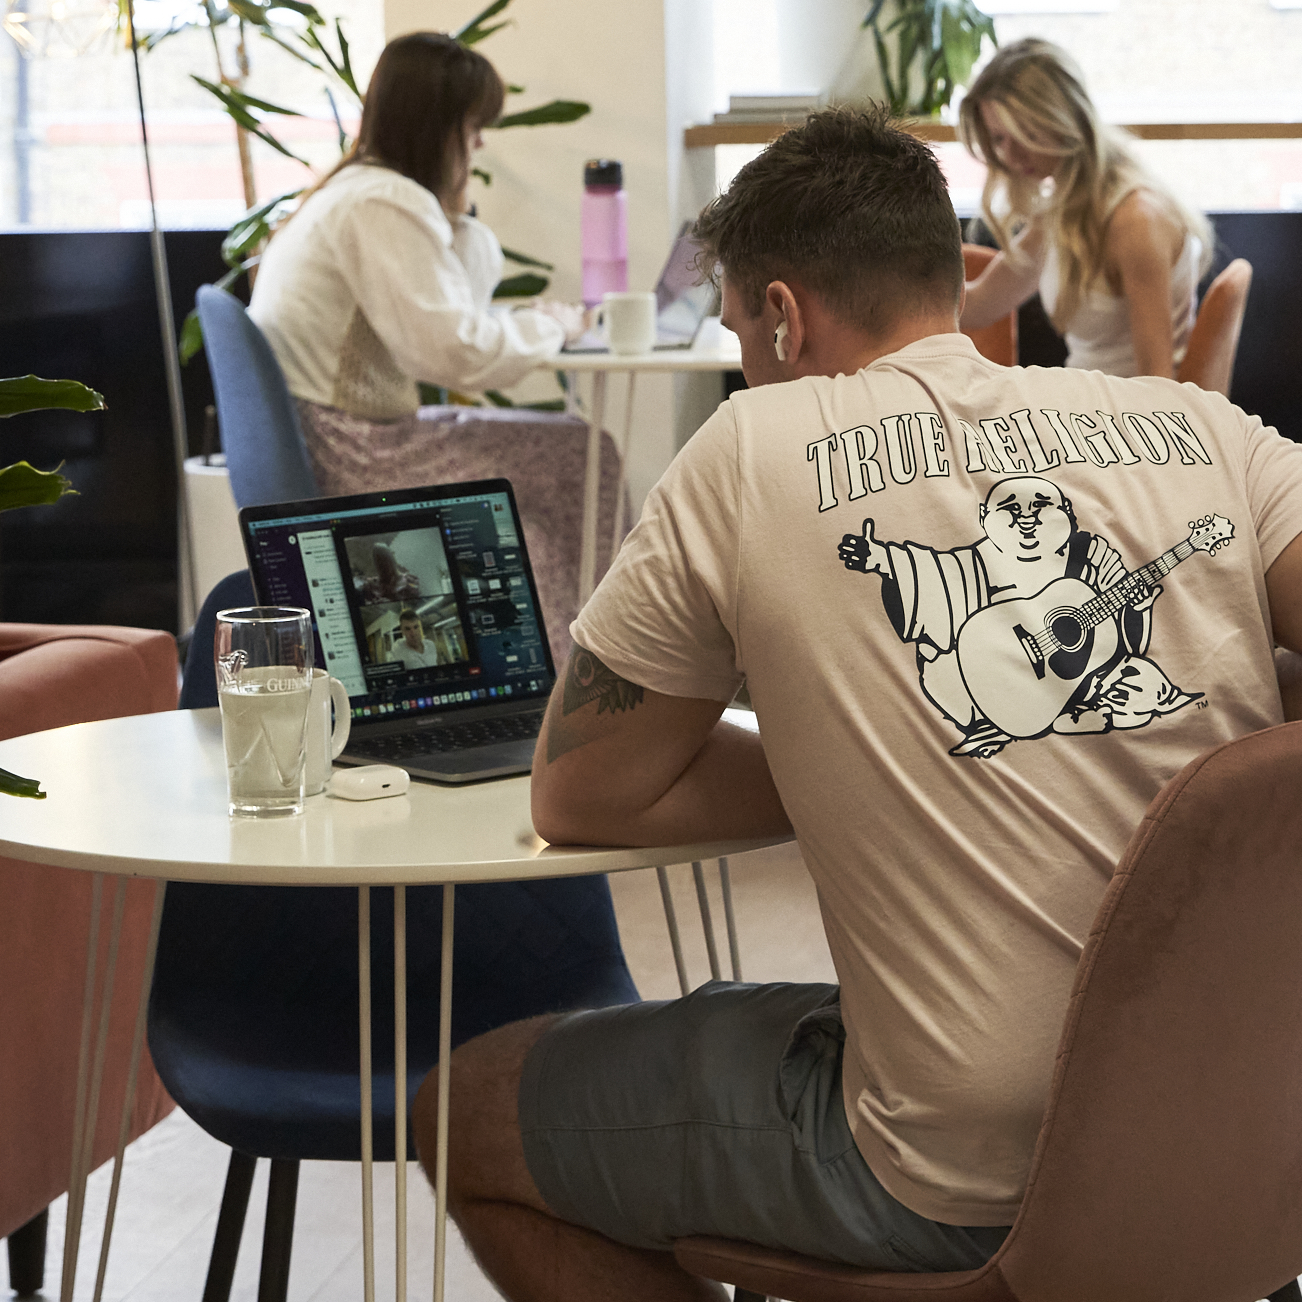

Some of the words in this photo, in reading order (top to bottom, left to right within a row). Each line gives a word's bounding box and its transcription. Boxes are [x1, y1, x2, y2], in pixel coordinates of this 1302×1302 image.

[807, 412, 950, 513] TRUE
[957, 408, 1213, 474] RELIGION
[1195, 699, 1209, 710] TM
